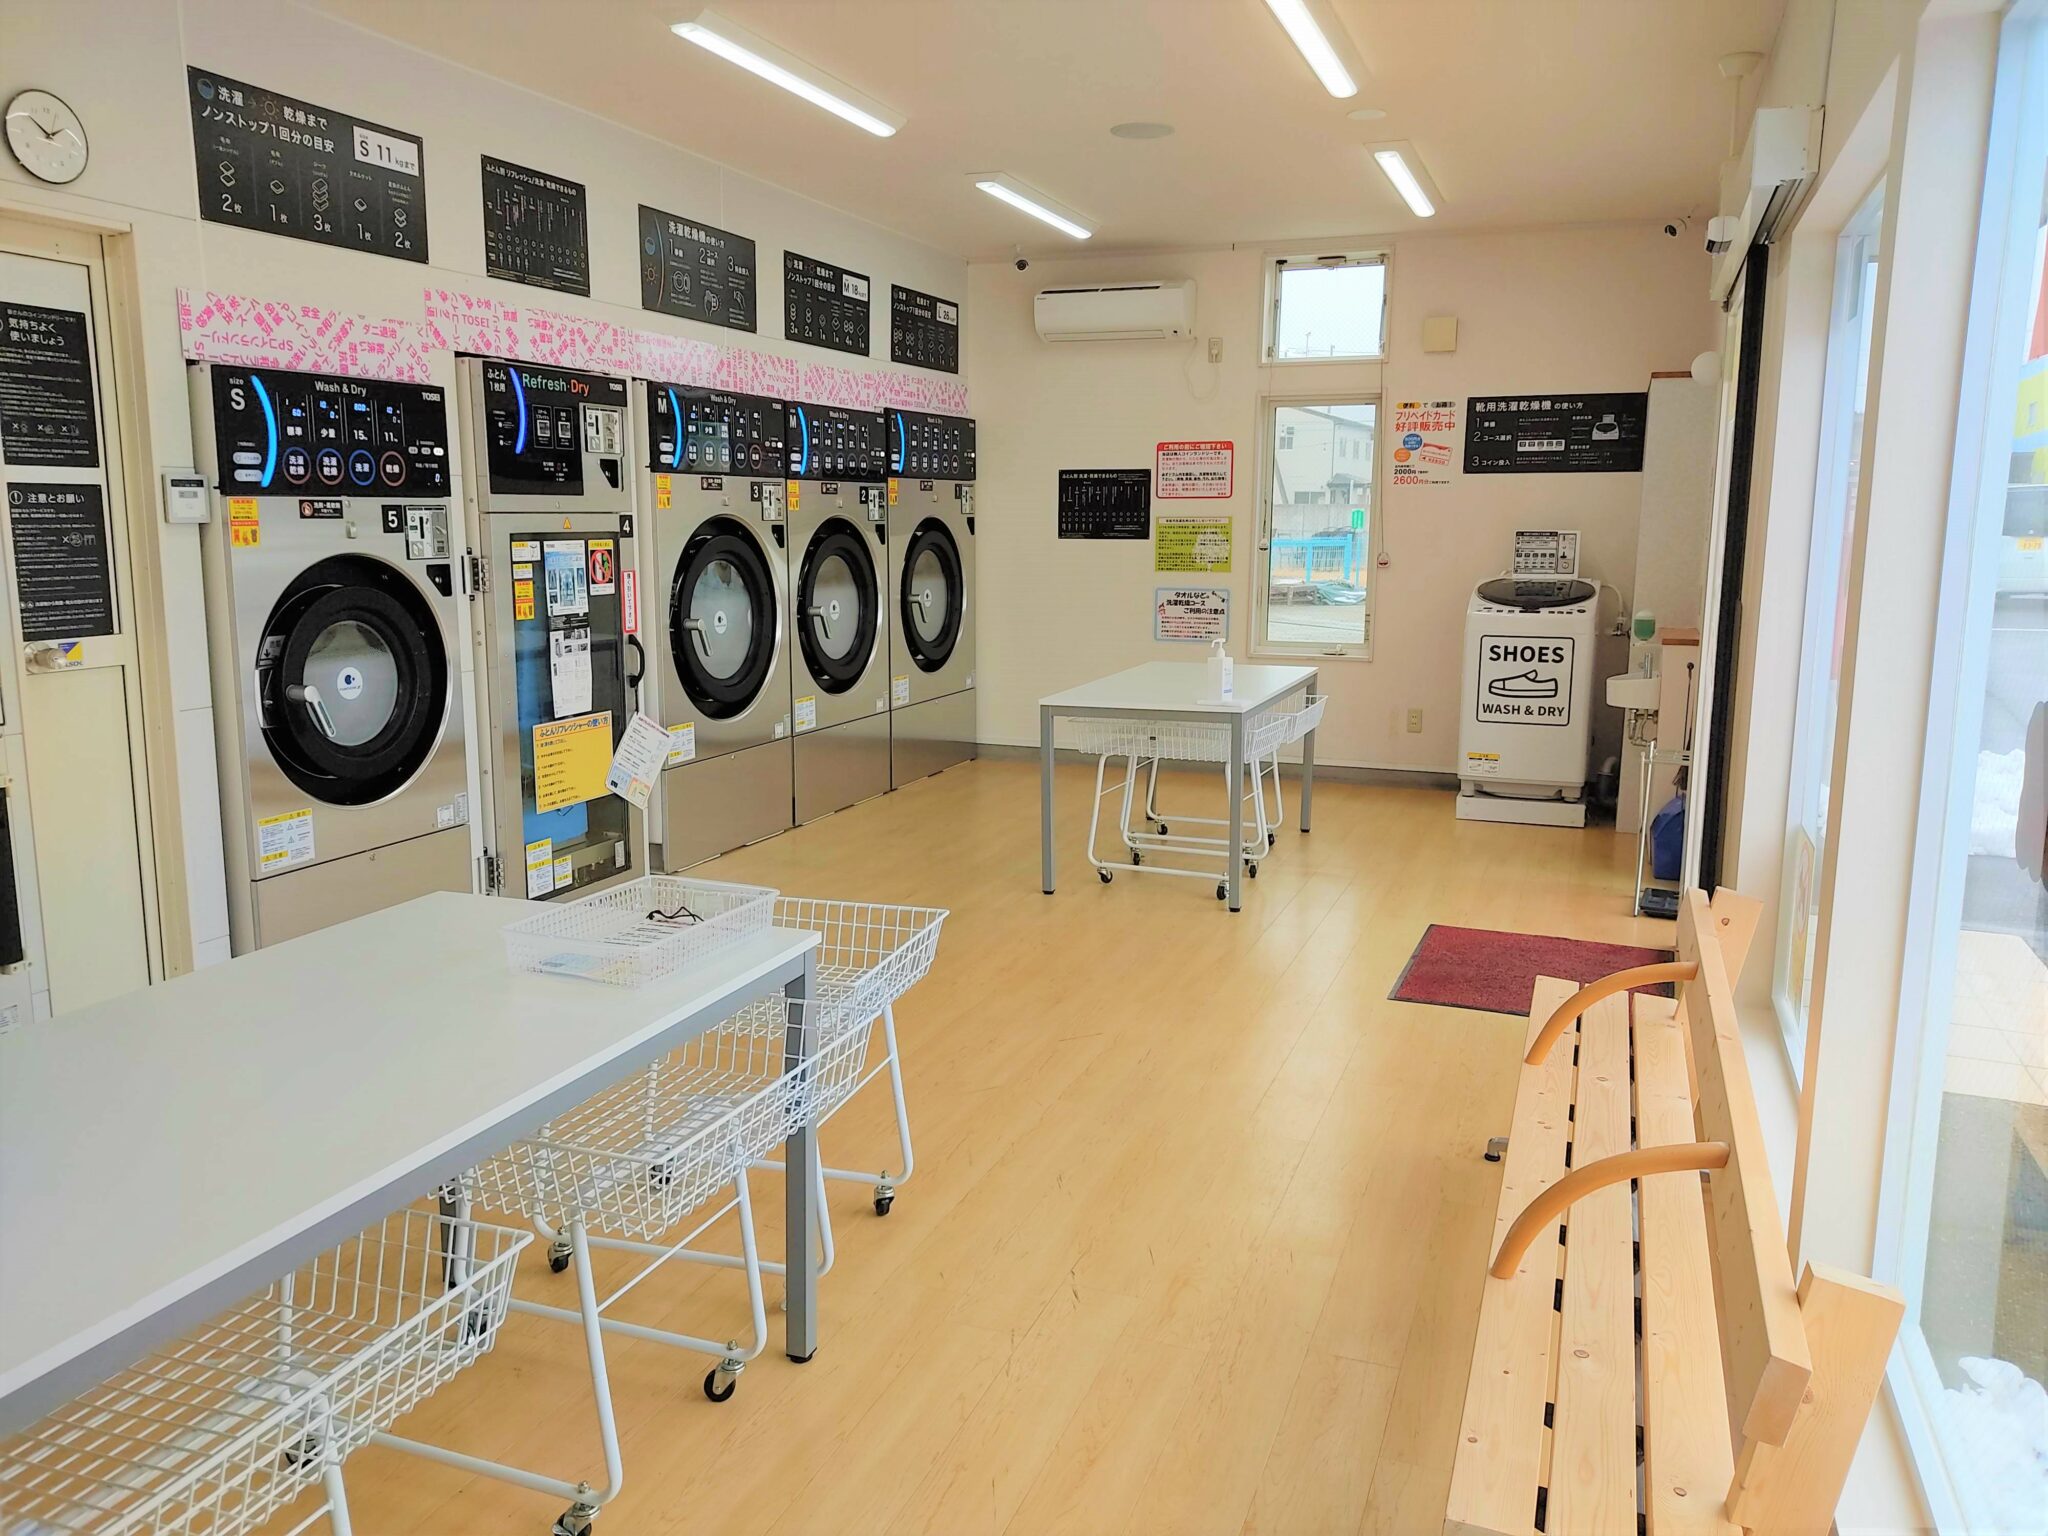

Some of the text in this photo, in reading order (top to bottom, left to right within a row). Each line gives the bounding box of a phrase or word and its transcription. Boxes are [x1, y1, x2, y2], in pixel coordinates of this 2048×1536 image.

[217, 84, 328, 131] 洗濯 乾燥まで
[201, 105, 335, 154] ノンストップ1回分の目安
[360, 140, 369, 157] S
[377, 144, 391, 163] 11
[222, 193, 243, 214] 2枚
[270, 204, 288, 224] 1枚
[313, 213, 332, 233] 3枚
[357, 223, 372, 241] 1枚
[394, 231, 411, 249] 2枚
[669, 238, 674, 255] 1
[699, 247, 706, 264] 2
[727, 255, 734, 272] 3
[843, 281, 850, 293] M
[8, 317, 57, 334] 気持ちよく
[461, 313, 490, 328] TOSEI
[9, 330, 65, 346] 使いましょう
[229, 377, 244, 385] size
[487, 368, 506, 381] ふとん
[315, 380, 367, 397] Wash & Dry
[421, 391, 440, 402] TOSEI
[230, 388, 246, 411] S
[657, 397, 668, 414] M
[1475, 400, 1583, 412] 靴用洗濯乾燥機 の使い方
[789, 414, 797, 429] M
[1395, 410, 1456, 421] プリペイドカード
[1476, 417, 1480, 428] 1
[1395, 421, 1456, 432] 好評販売中
[1473, 431, 1481, 442] 2
[1471, 455, 1480, 467] 3
[27, 492, 85, 504] 注意とお願い
[752, 485, 759, 498] 3
[861, 489, 866, 501] 2
[388, 510, 398, 528] 5
[622, 519, 631, 534] 4
[1488, 644, 1565, 664] SHOES
[1482, 703, 1565, 717] WASH & DRY
